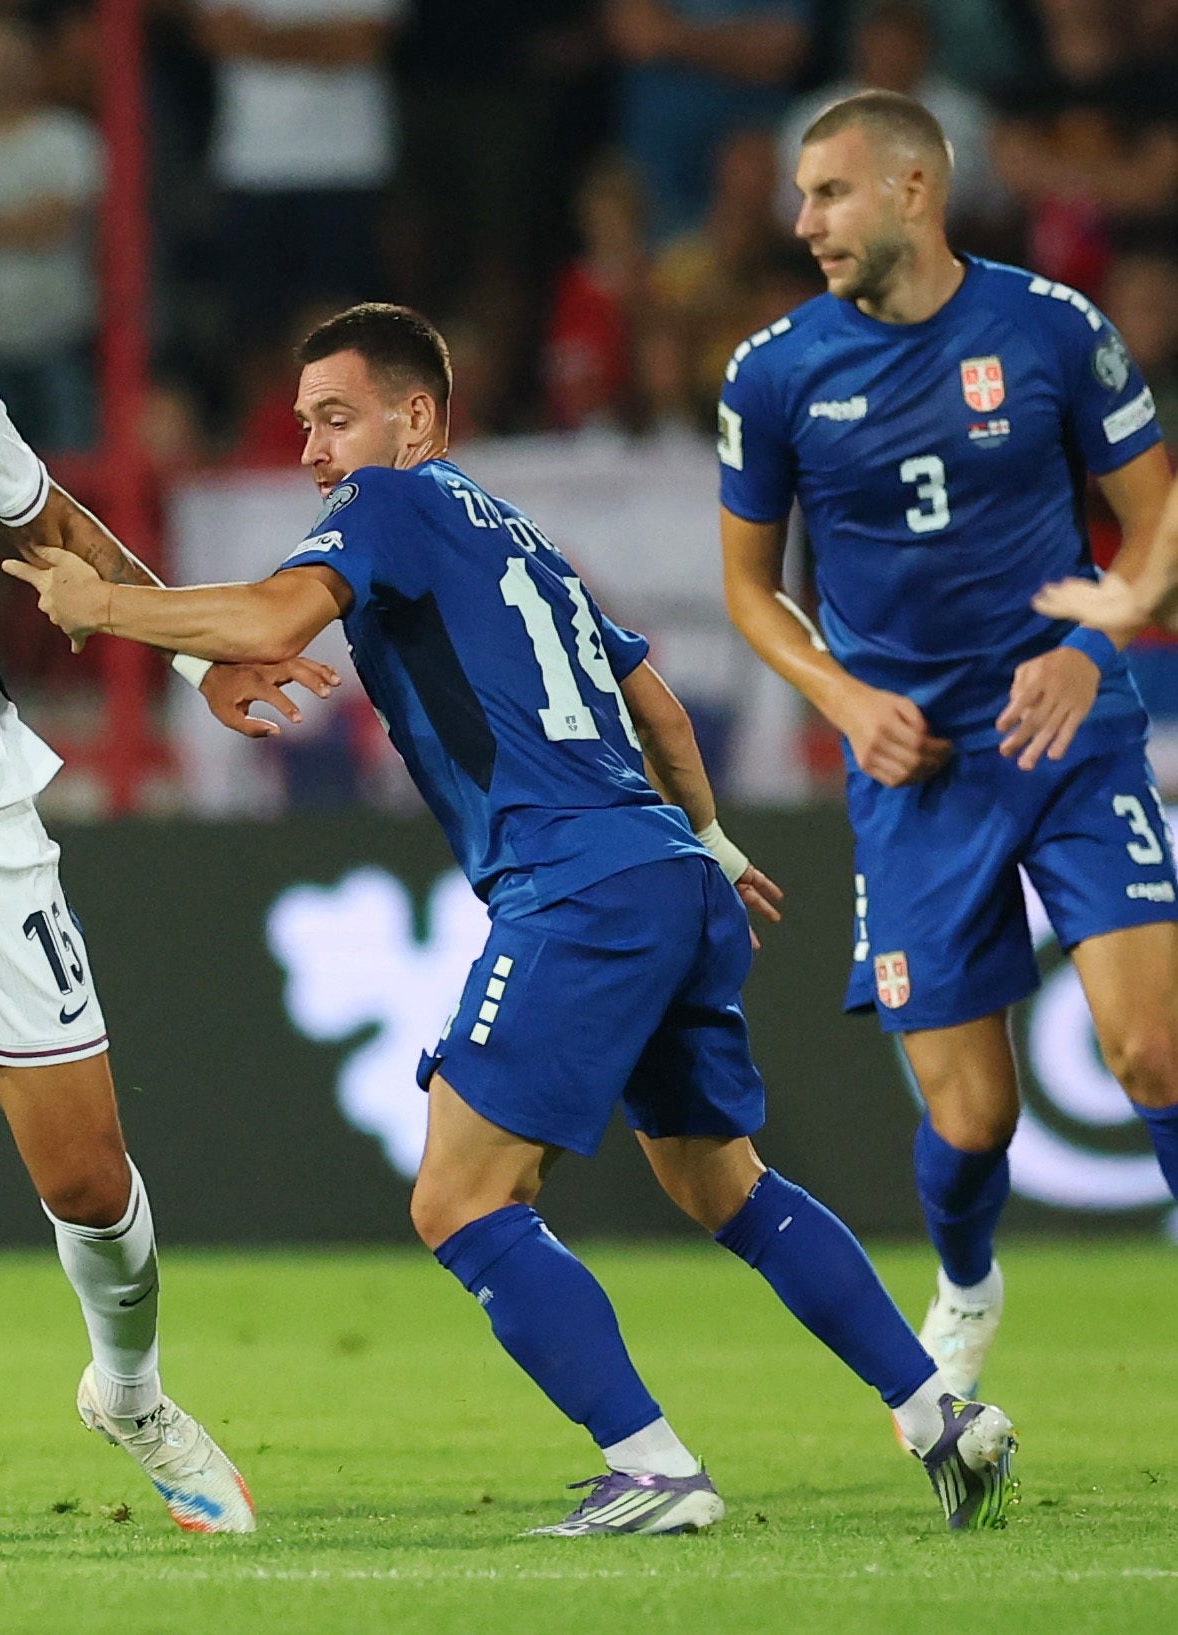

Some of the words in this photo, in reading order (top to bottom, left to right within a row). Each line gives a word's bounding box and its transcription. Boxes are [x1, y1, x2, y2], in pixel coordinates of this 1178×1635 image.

[900, 454, 950, 533] 3
[499, 557, 642, 752] 14
[1112, 795, 1163, 865] 3
[22, 900, 86, 995] 15
